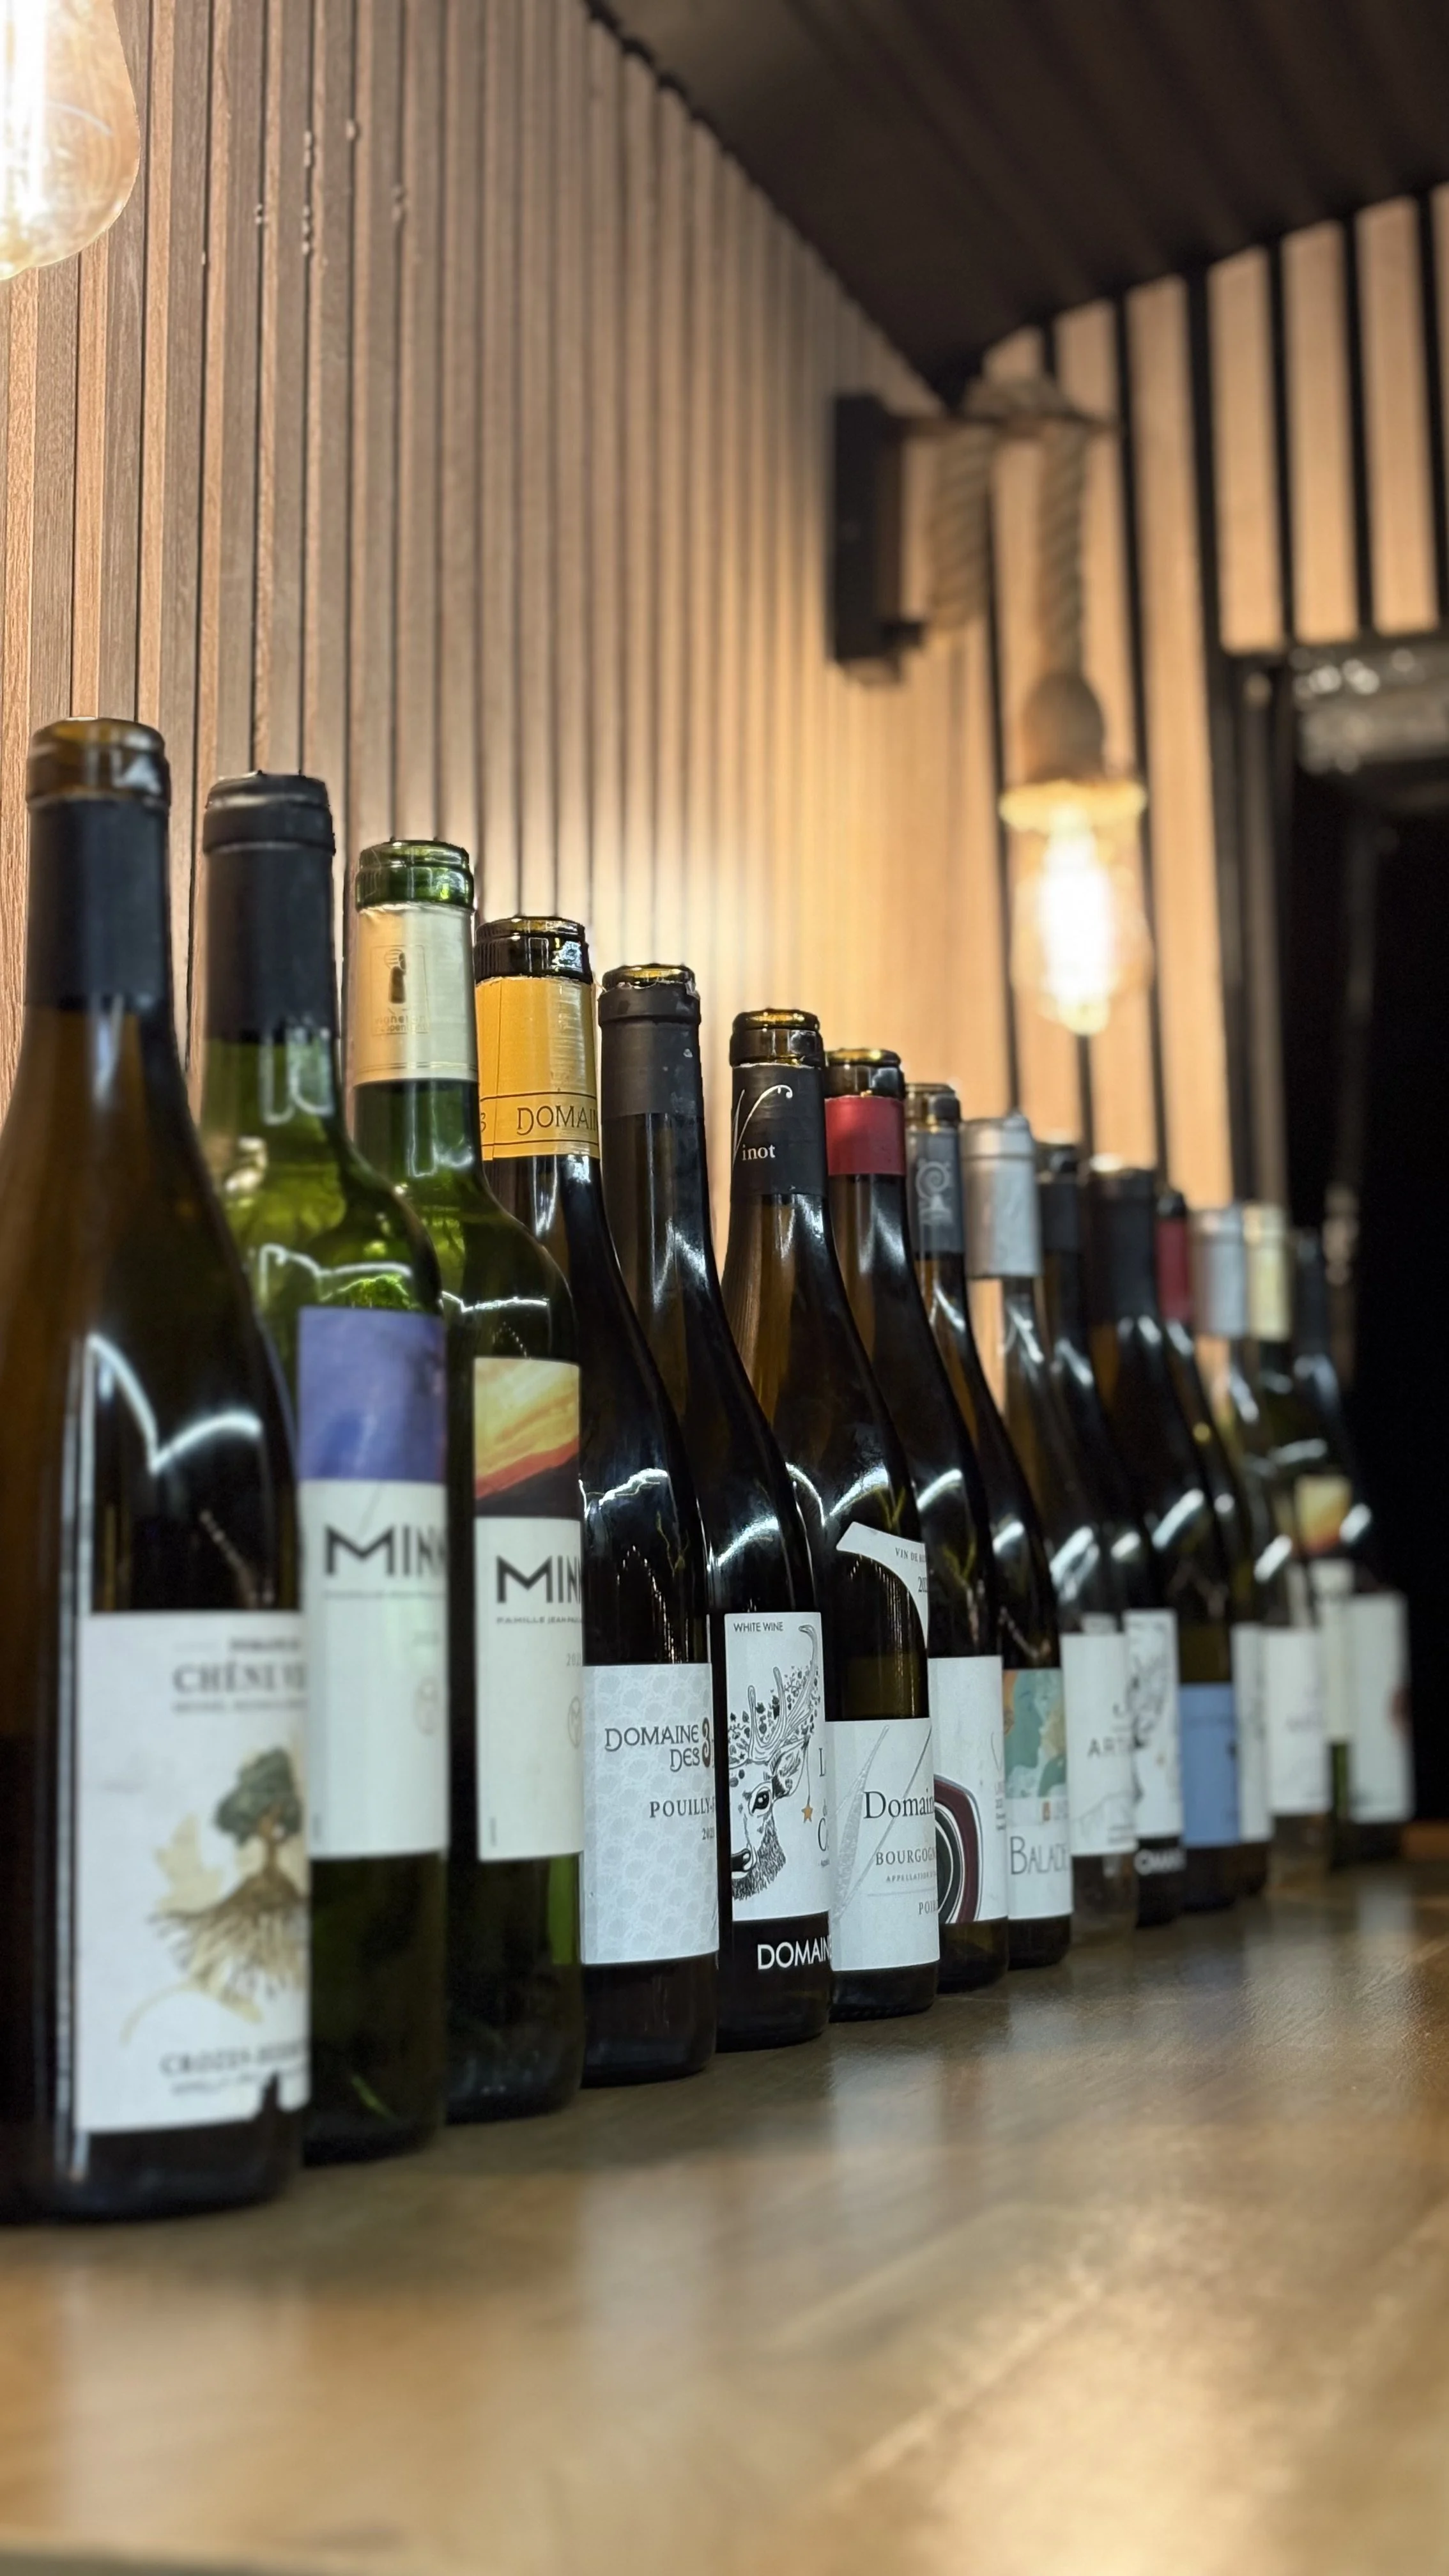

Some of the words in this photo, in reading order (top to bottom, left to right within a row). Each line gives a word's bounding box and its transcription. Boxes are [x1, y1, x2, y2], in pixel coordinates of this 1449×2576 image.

[733, 1622, 762, 1632] WHITE
[763, 1621, 784, 1632] WINE
[604, 1725, 700, 1752] DOMAINE
[670, 1747, 700, 1772] DES
